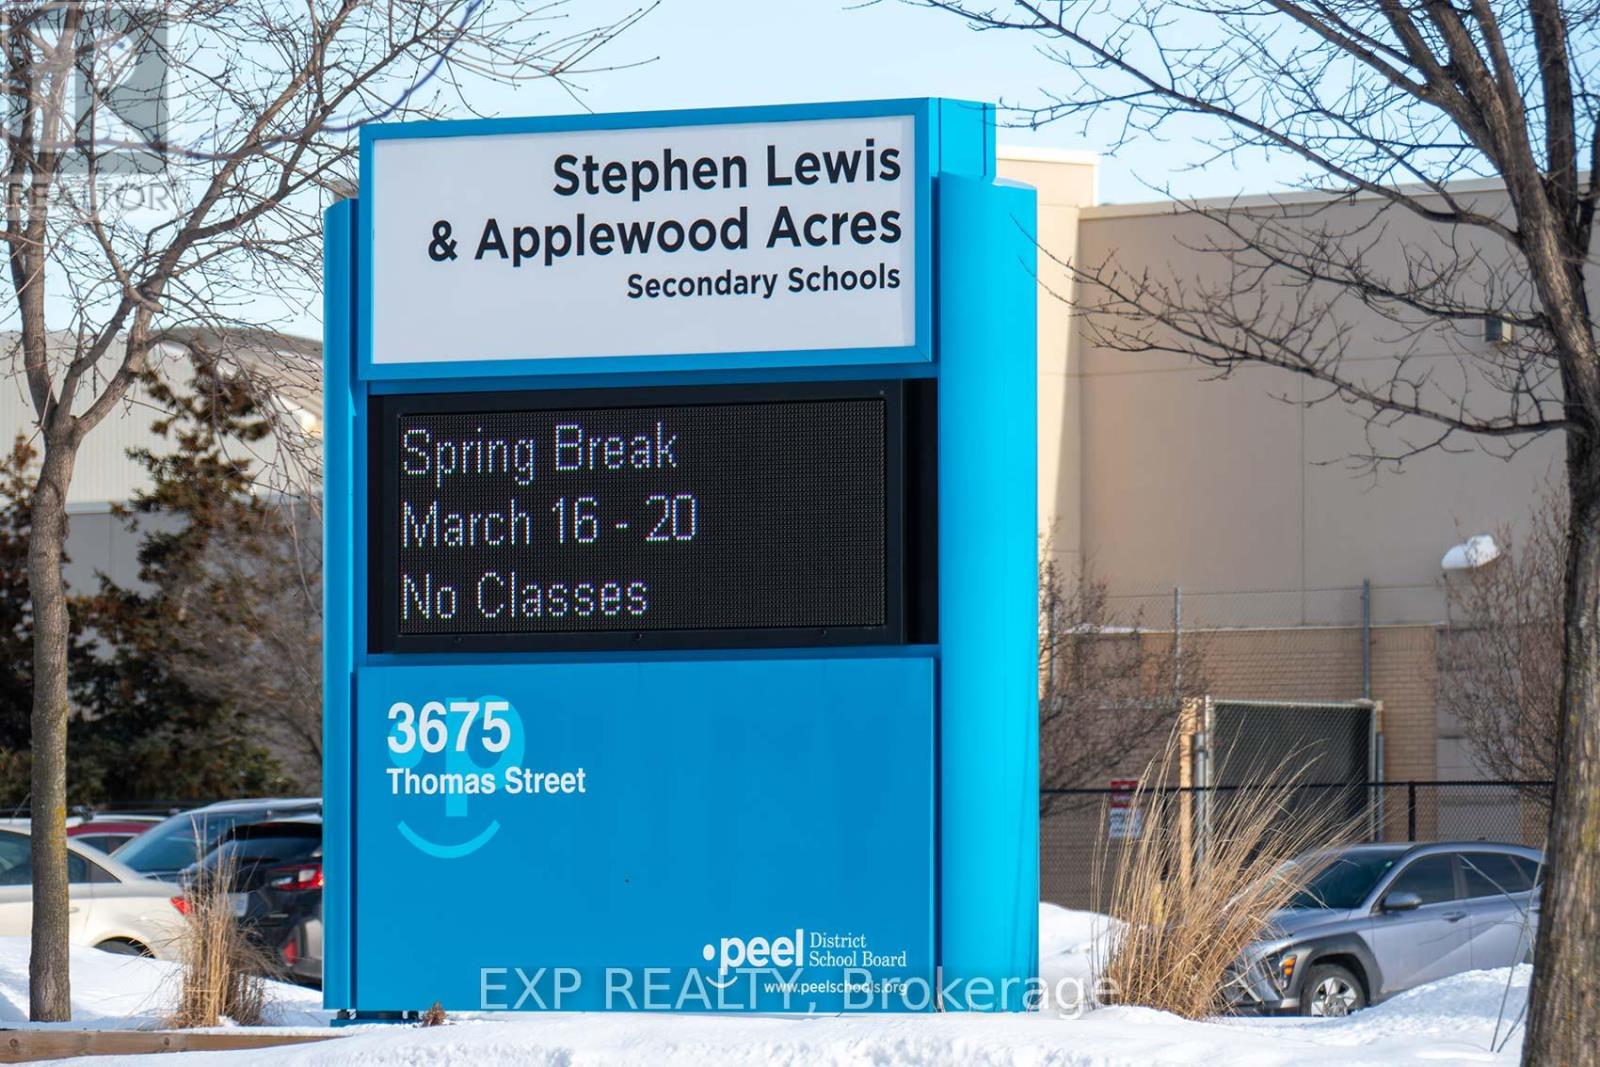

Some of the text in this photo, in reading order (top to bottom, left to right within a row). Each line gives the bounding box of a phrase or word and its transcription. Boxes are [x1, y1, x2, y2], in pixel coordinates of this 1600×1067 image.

[553, 138, 901, 201] Stephen Lewis
[428, 205, 901, 267] & Applewood Acres
[627, 263, 901, 299] Secondary Schools
[403, 421, 677, 487] Spring Break
[403, 499, 531, 548] March
[551, 496, 598, 544] 16
[645, 494, 697, 541] 20
[403, 571, 648, 620] No Classes
[387, 701, 511, 753] 3675
[386, 766, 586, 795] Thomas Street
[720, 928, 804, 976] peel
[809, 931, 867, 949] District
[809, 951, 907, 968] School Board
[764, 979, 908, 996] www.peelschools.org
